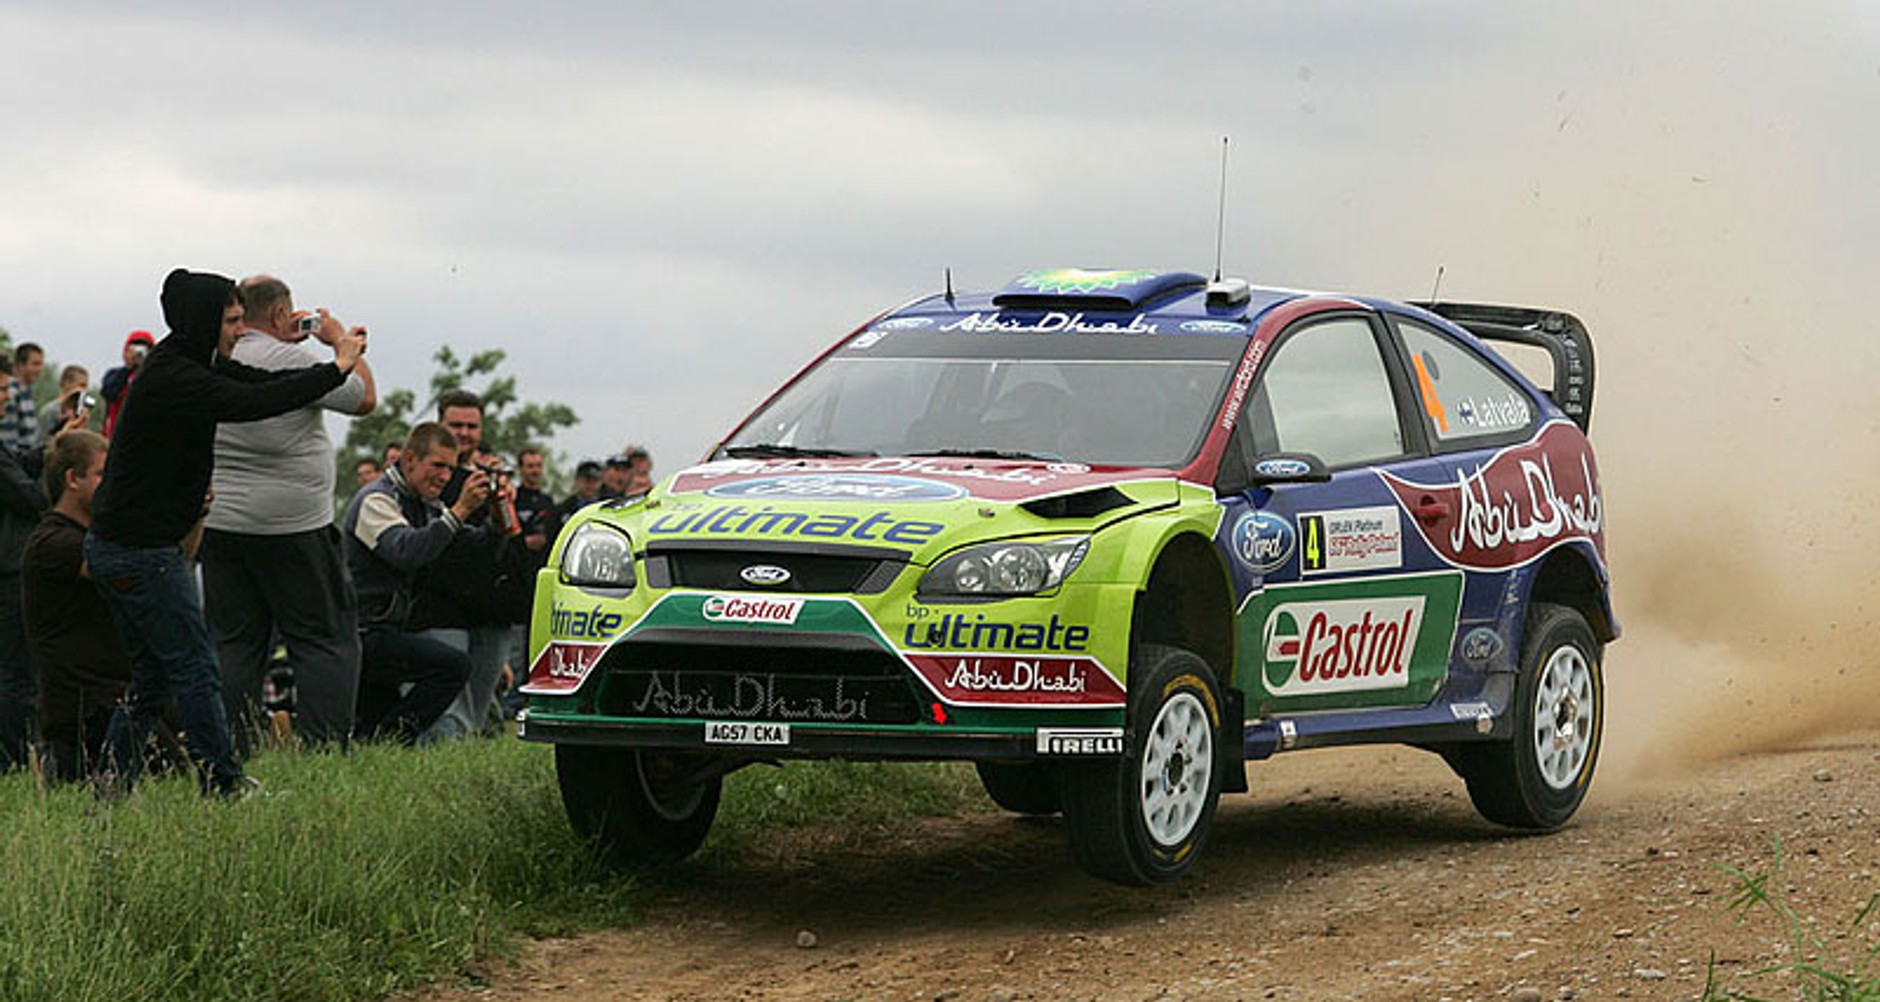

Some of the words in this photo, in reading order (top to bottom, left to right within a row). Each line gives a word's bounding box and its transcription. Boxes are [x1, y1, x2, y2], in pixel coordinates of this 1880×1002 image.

[1412, 353, 1448, 432] 4
[648, 505, 945, 545] ultimate
[1243, 520, 1283, 560] Ford
[1306, 517, 1319, 568] 4
[724, 598, 796, 620] Castrol
[906, 604, 930, 618] bp
[904, 614, 1090, 651] ultimate
[1299, 609, 1413, 682] Castrol
[711, 725, 748, 741] AG57
[754, 725, 782, 741] CKA
[1036, 727, 1124, 754] PIRELLI
